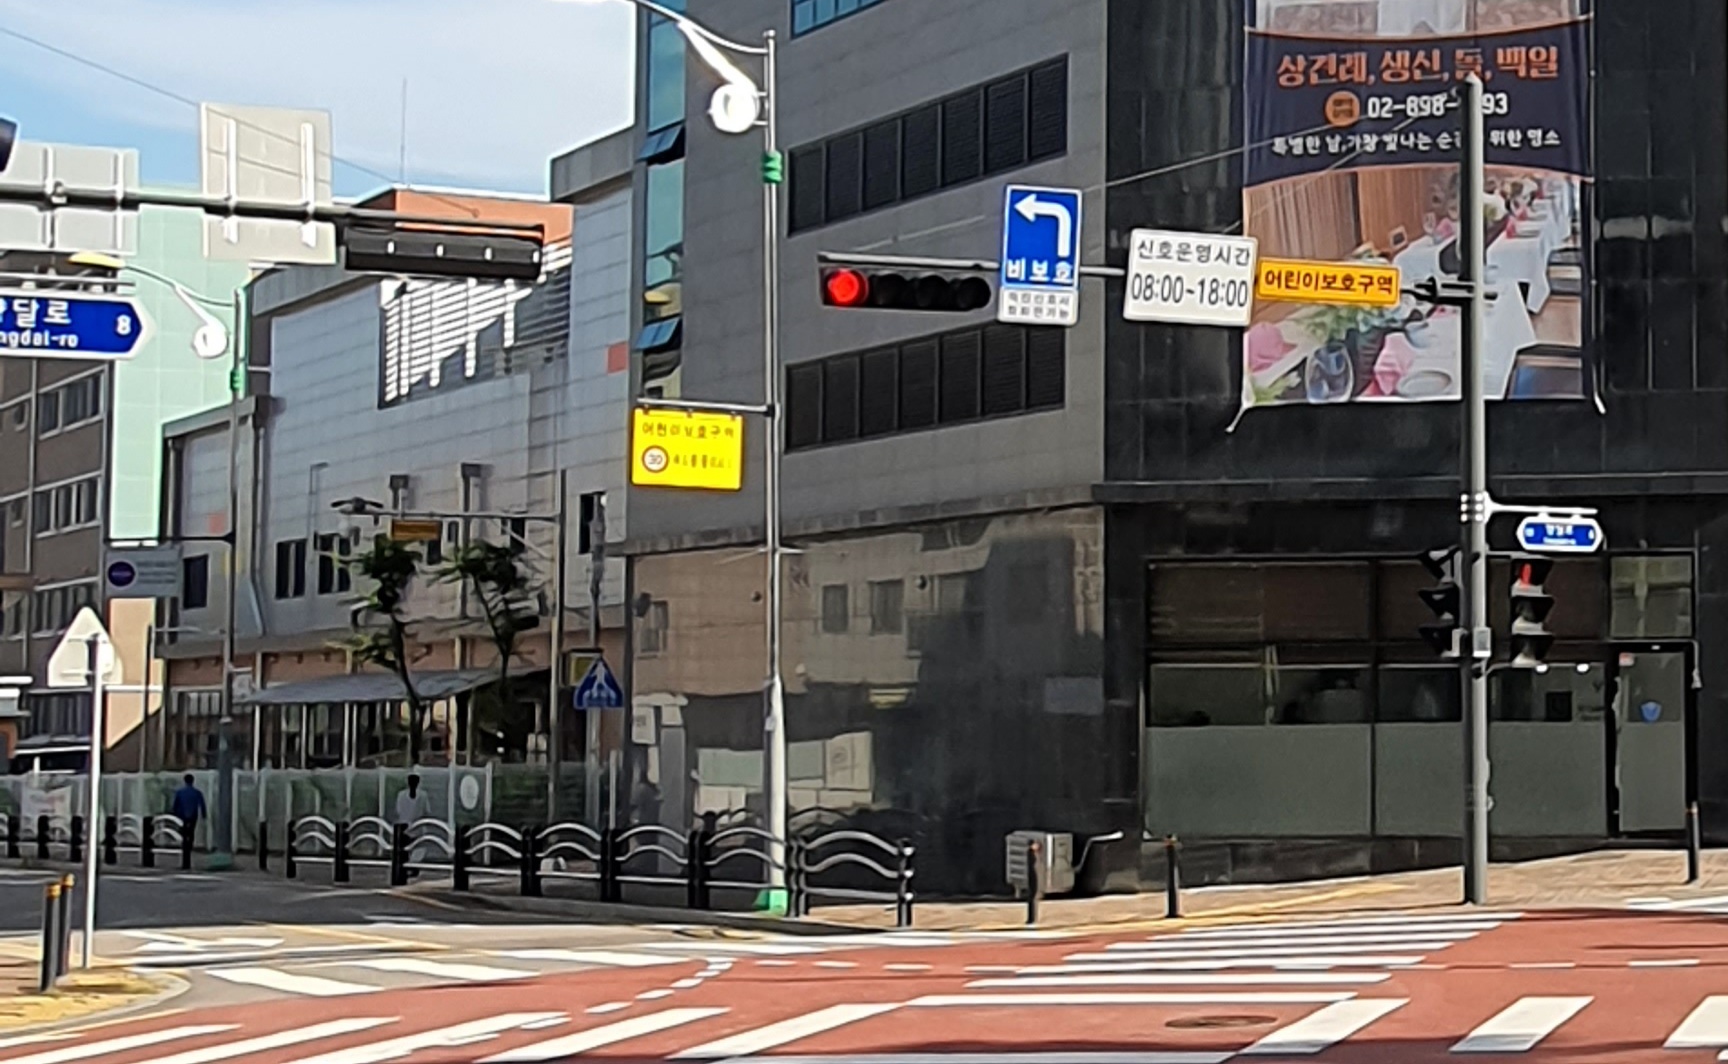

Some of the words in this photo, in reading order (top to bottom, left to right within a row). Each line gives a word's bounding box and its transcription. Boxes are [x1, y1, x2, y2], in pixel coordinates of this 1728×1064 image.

[1379, 48, 1450, 81] 생신,
[1496, 45, 1559, 78] 백일
[1366, 91, 1508, 120] 02-898-93
[1136, 240, 1251, 265] 신호운영시간
[1005, 257, 1074, 284] 비보호
[1263, 270, 1394, 294] 어린이보호구역
[1131, 273, 1249, 307] 08:00~18:00
[116, 314, 132, 336] 8
